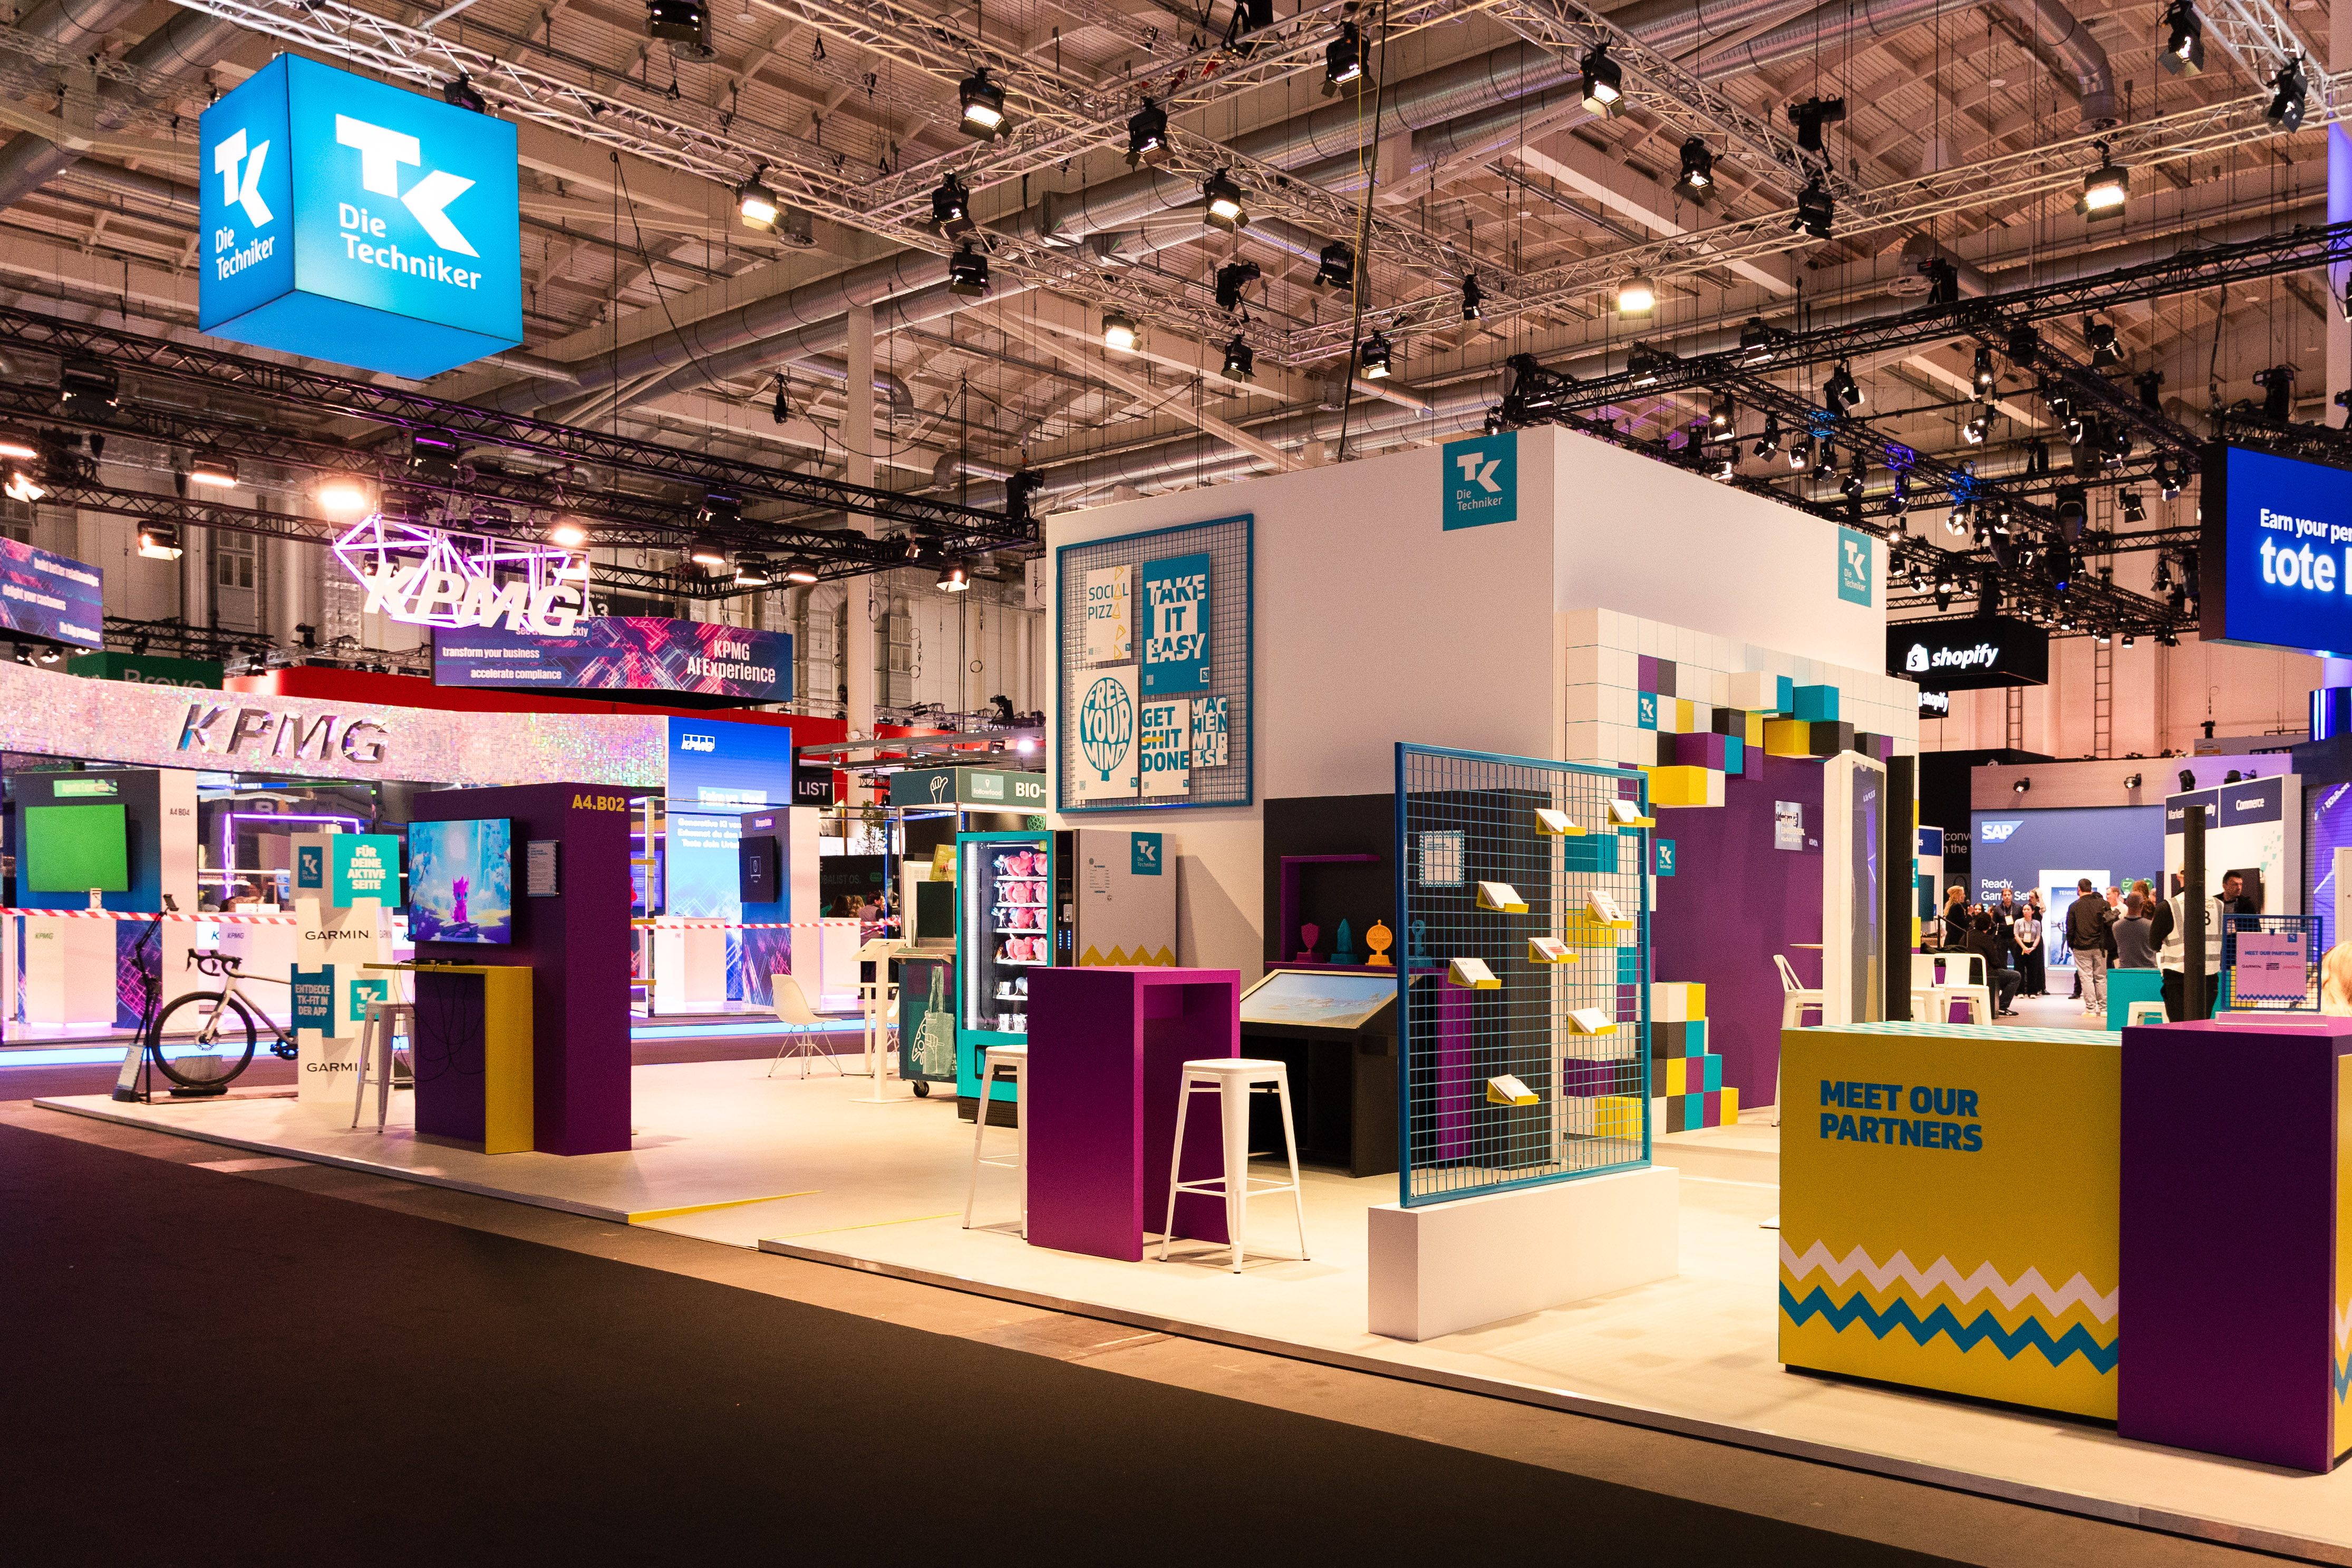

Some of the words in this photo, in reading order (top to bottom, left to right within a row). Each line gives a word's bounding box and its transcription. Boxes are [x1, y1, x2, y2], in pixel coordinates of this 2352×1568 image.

[214, 128, 274, 228] TK
[336, 113, 481, 258] TK
[339, 202, 386, 238] Die
[215, 227, 235, 254] Die
[216, 236, 275, 280] Techniker
[340, 233, 482, 290] Techniker
[1457, 452, 1502, 492] TK
[1457, 489, 1472, 500] Die
[1457, 497, 1503, 511] Techniker
[2260, 508, 2293, 531] Earn
[2296, 518, 2328, 538] your
[1844, 540, 1865, 580] TK
[2260, 536, 2336, 592] tote
[1146, 574, 1206, 606] TAKE
[1844, 578, 1866, 592] Techniker
[363, 563, 582, 637] KPMG
[1165, 606, 1186, 633] IT
[442, 646, 483, 659] transform
[484, 649, 502, 659] your
[502, 647, 540, 659] business
[713, 639, 750, 661] KPMG
[1146, 633, 1206, 664] EASY
[1931, 643, 1999, 669] shopify
[471, 669, 514, 679] accelerate
[515, 669, 562, 680] compliance
[688, 661, 702, 676] AI
[702, 661, 776, 684] Experience
[1085, 679, 1127, 709] FREE
[1923, 692, 1949, 712] shopify
[1141, 706, 1175, 728] GET
[1641, 699, 1653, 718] TK
[1083, 701, 1130, 743] YOUR
[176, 703, 391, 764] KPMG
[681, 740, 714, 752] KPMG
[1084, 742, 1127, 771] MIND
[1141, 751, 1189, 772] DONE
[973, 788, 1002, 796] followfood
[572, 794, 625, 812] A4.B02
[2236, 798, 2264, 811] Commerce
[2168, 807, 2184, 820] Marketi
[1982, 825, 2013, 839] SAP
[355, 845, 377, 857] FÜR
[1137, 841, 1156, 860] TK
[1660, 846, 1671, 864] TK
[1951, 844, 1967, 854] the
[303, 854, 317, 874] TK
[351, 857, 382, 868] DEINE
[347, 868, 386, 879] AKTIVE
[820, 875, 848, 884] BALIST
[352, 879, 381, 889] SEITE
[1981, 879, 2013, 889] Ready.
[1981, 891, 2003, 901] Gam
[305, 930, 369, 940] GARMIN
[295, 984, 331, 995] ENTDECKE
[297, 995, 320, 1005] TK-FIT
[321, 995, 328, 1005] IN
[298, 1006, 312, 1015] DER
[313, 1007, 327, 1016] APP
[1821, 1080, 1903, 1111] MEET
[1910, 1086, 1979, 1117] OUR
[1821, 1112, 1983, 1152] PARTNERS
